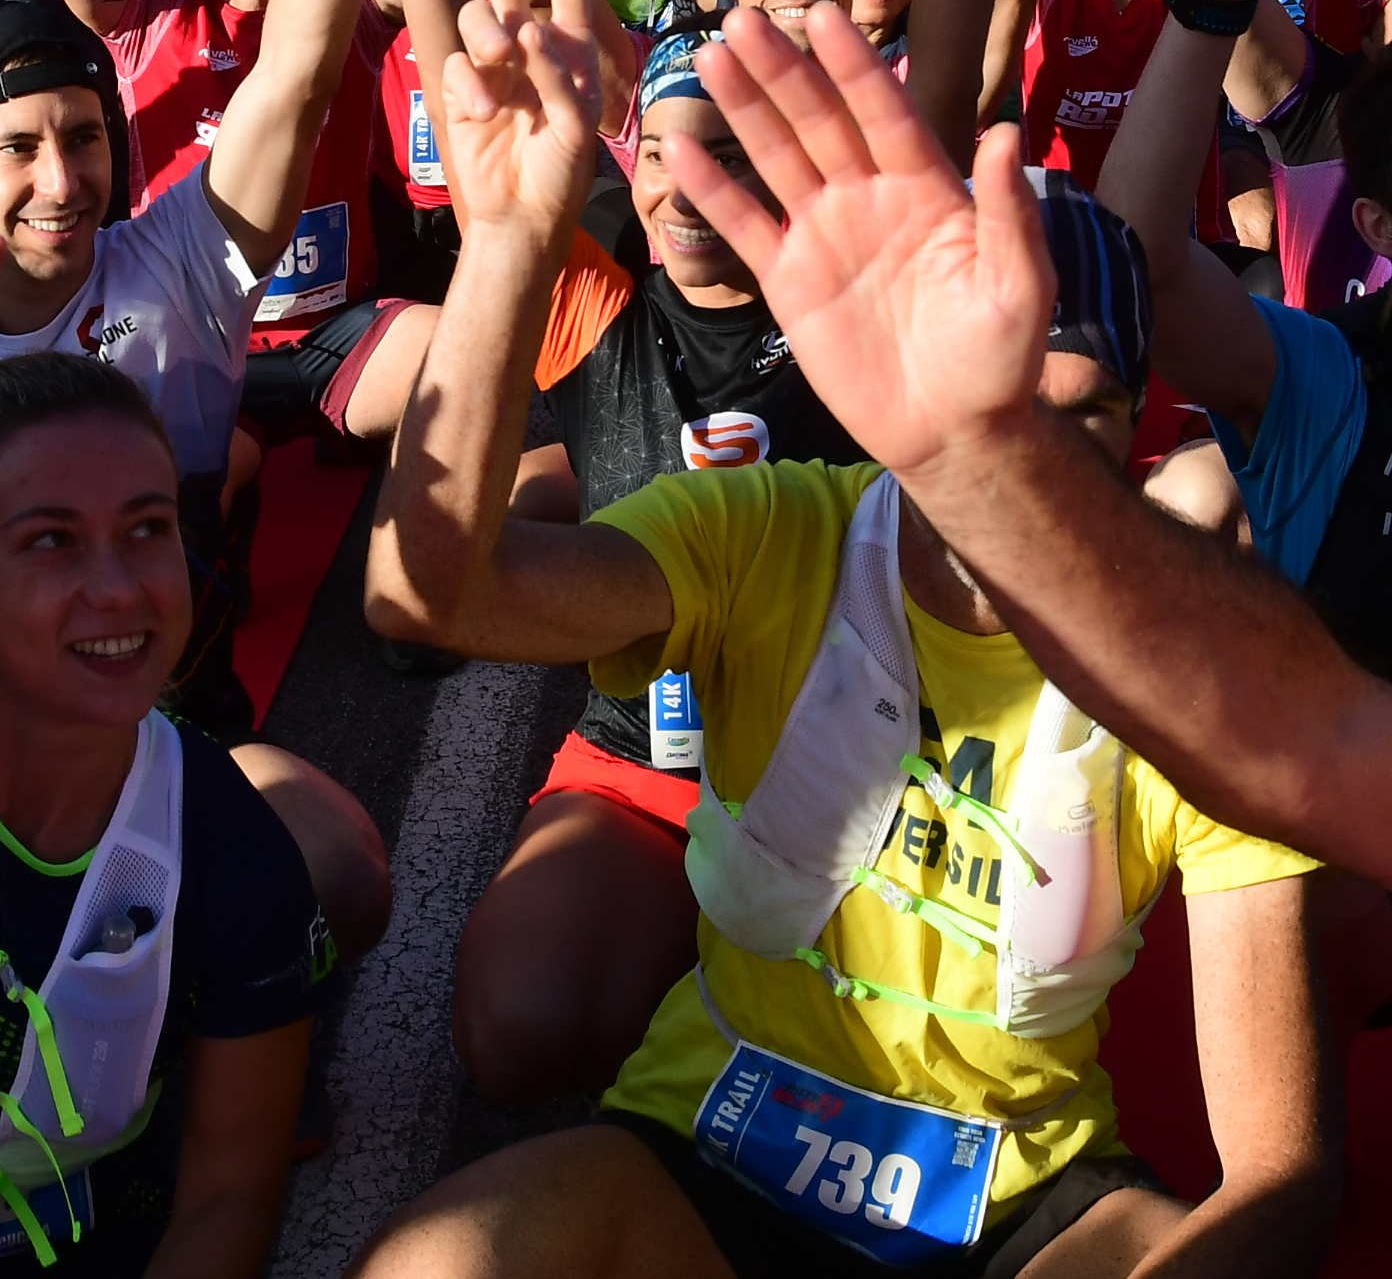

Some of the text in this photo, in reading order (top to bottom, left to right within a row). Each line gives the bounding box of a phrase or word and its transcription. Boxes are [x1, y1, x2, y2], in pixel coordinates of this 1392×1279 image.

[1081, 88, 1136, 108] POT
[662, 682, 683, 720] 14K
[877, 698, 896, 715] 250
[711, 1070, 761, 1133] TRAIL
[784, 1124, 922, 1230] 739
